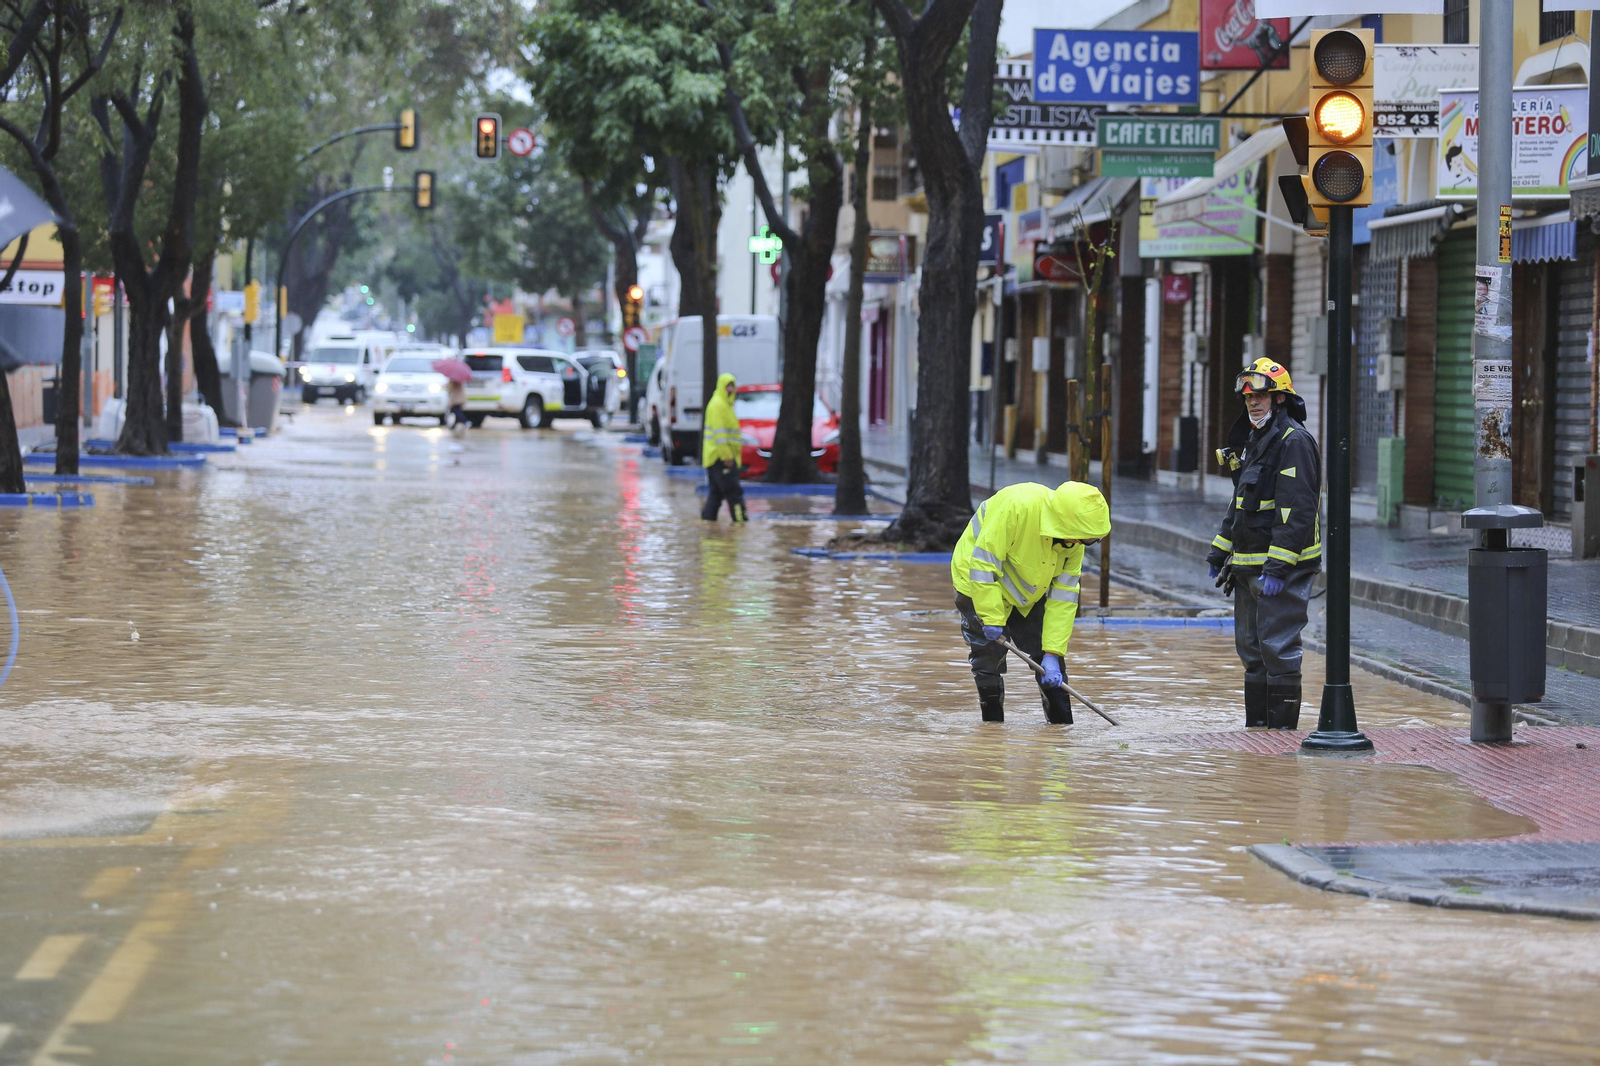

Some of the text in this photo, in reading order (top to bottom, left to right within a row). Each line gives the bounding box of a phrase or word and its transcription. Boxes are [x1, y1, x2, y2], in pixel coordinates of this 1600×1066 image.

[1048, 32, 1181, 68] Agencia
[1037, 61, 1192, 101] de Viajes
[1105, 121, 1215, 146] CAFETERIA
[1377, 113, 1406, 126] 952
[1410, 113, 1430, 126] 43
